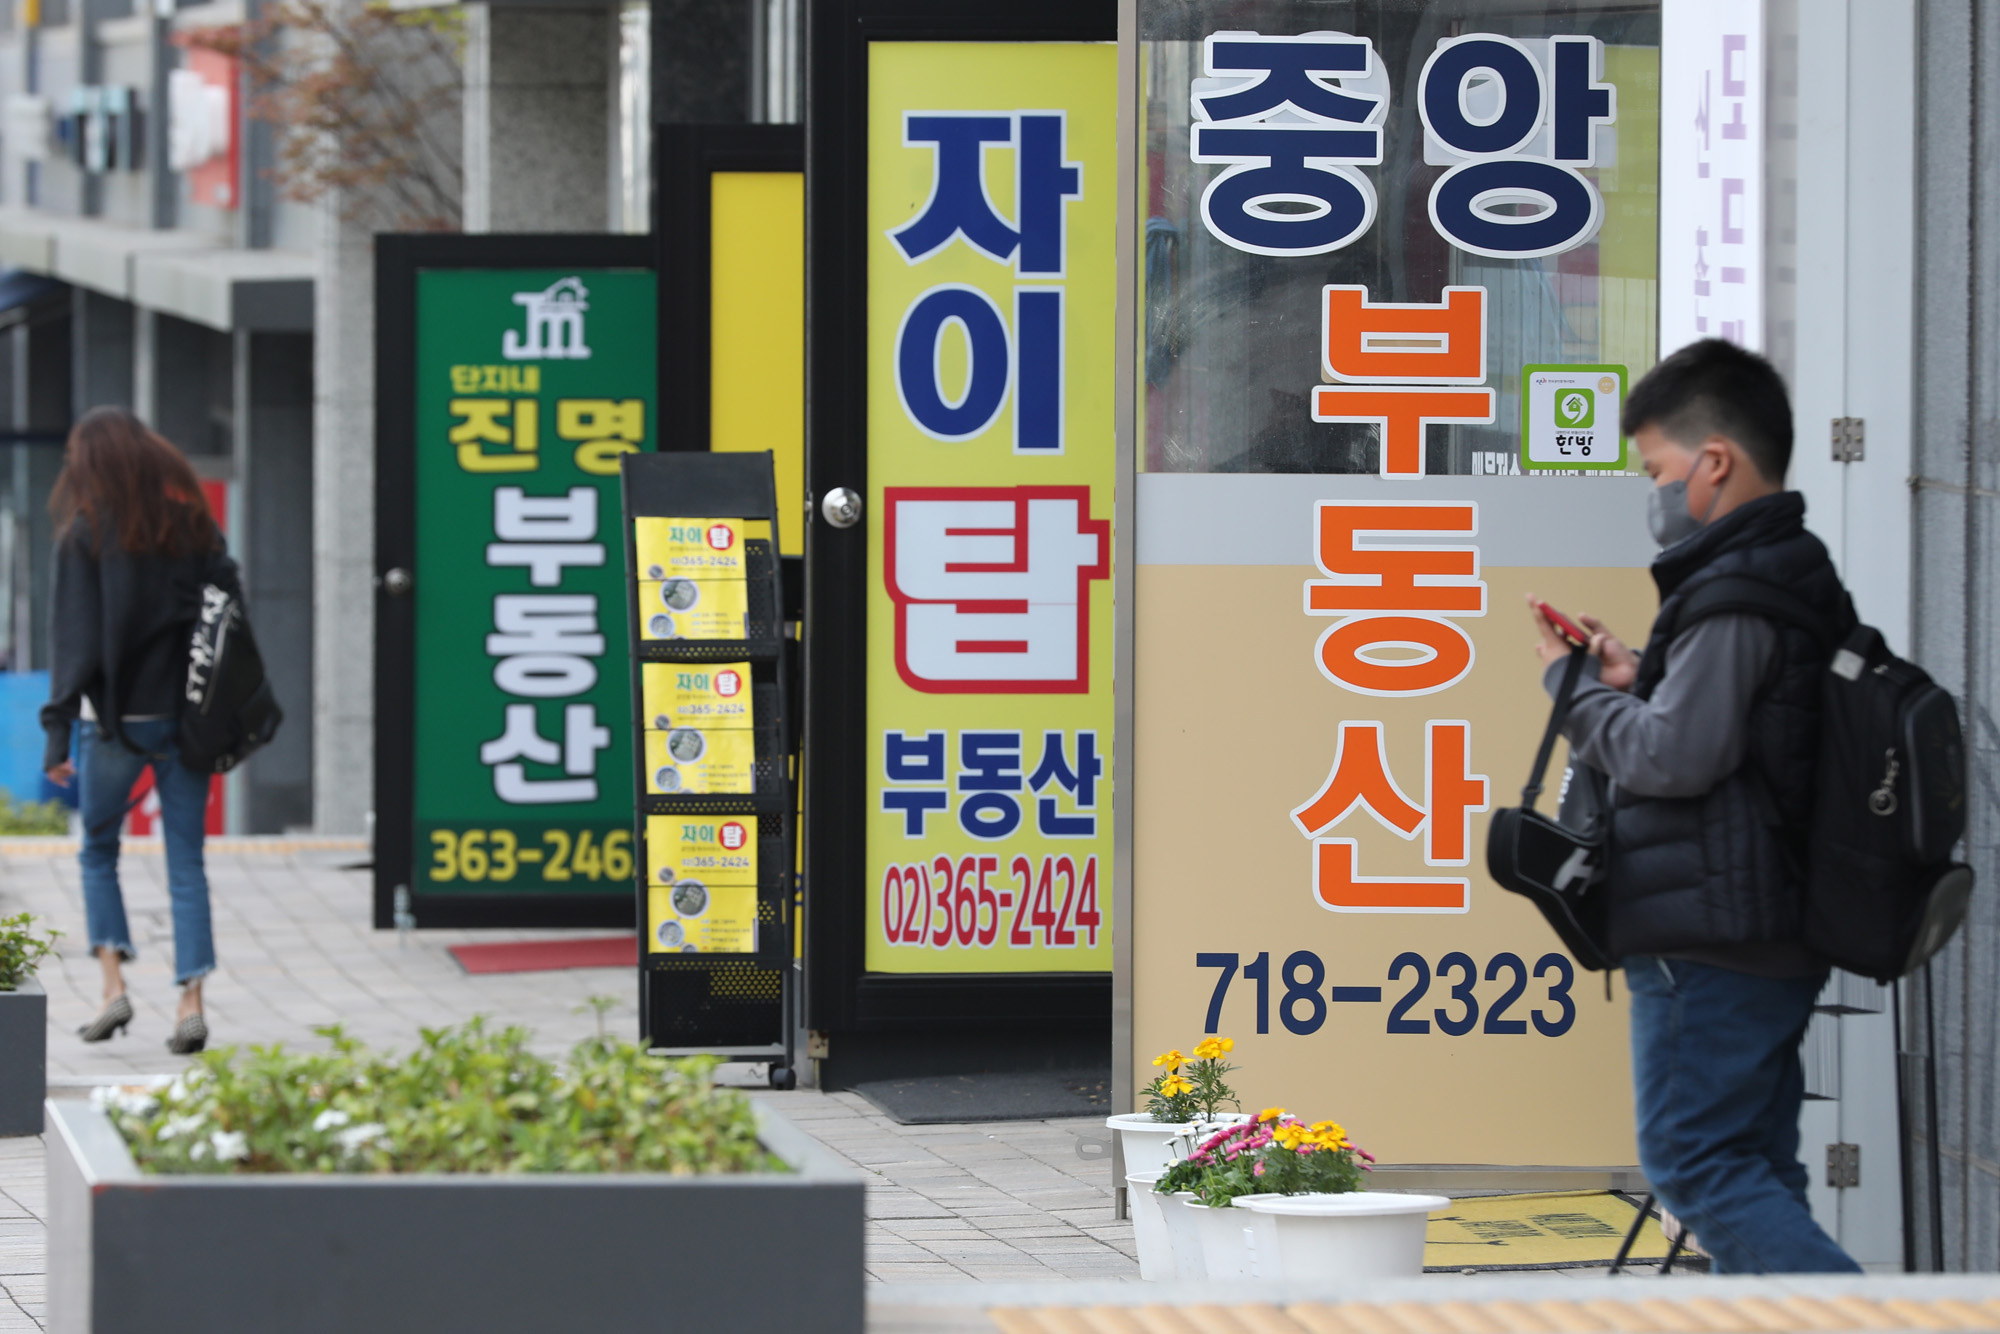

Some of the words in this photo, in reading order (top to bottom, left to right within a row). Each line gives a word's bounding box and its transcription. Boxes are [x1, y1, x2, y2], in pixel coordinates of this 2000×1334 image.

[1190, 34, 1616, 258] 중앙
[884, 109, 1083, 456] 자이
[450, 365, 540, 394] 단지내
[448, 398, 645, 476] 진명
[1555, 435, 1594, 457] 한방
[669, 526, 703, 544] 자이
[883, 484, 1111, 695] 탑
[1290, 285, 1496, 914] 부동산
[480, 486, 611, 804] 부동산
[676, 672, 710, 691] 자이
[882, 730, 1103, 840] 부동산
[429, 829, 648, 882] 363-246
[681, 824, 715, 843] 자이
[882, 855, 1101, 949] 02)365-2424
[1196, 950, 1577, 1038] 718-2323
